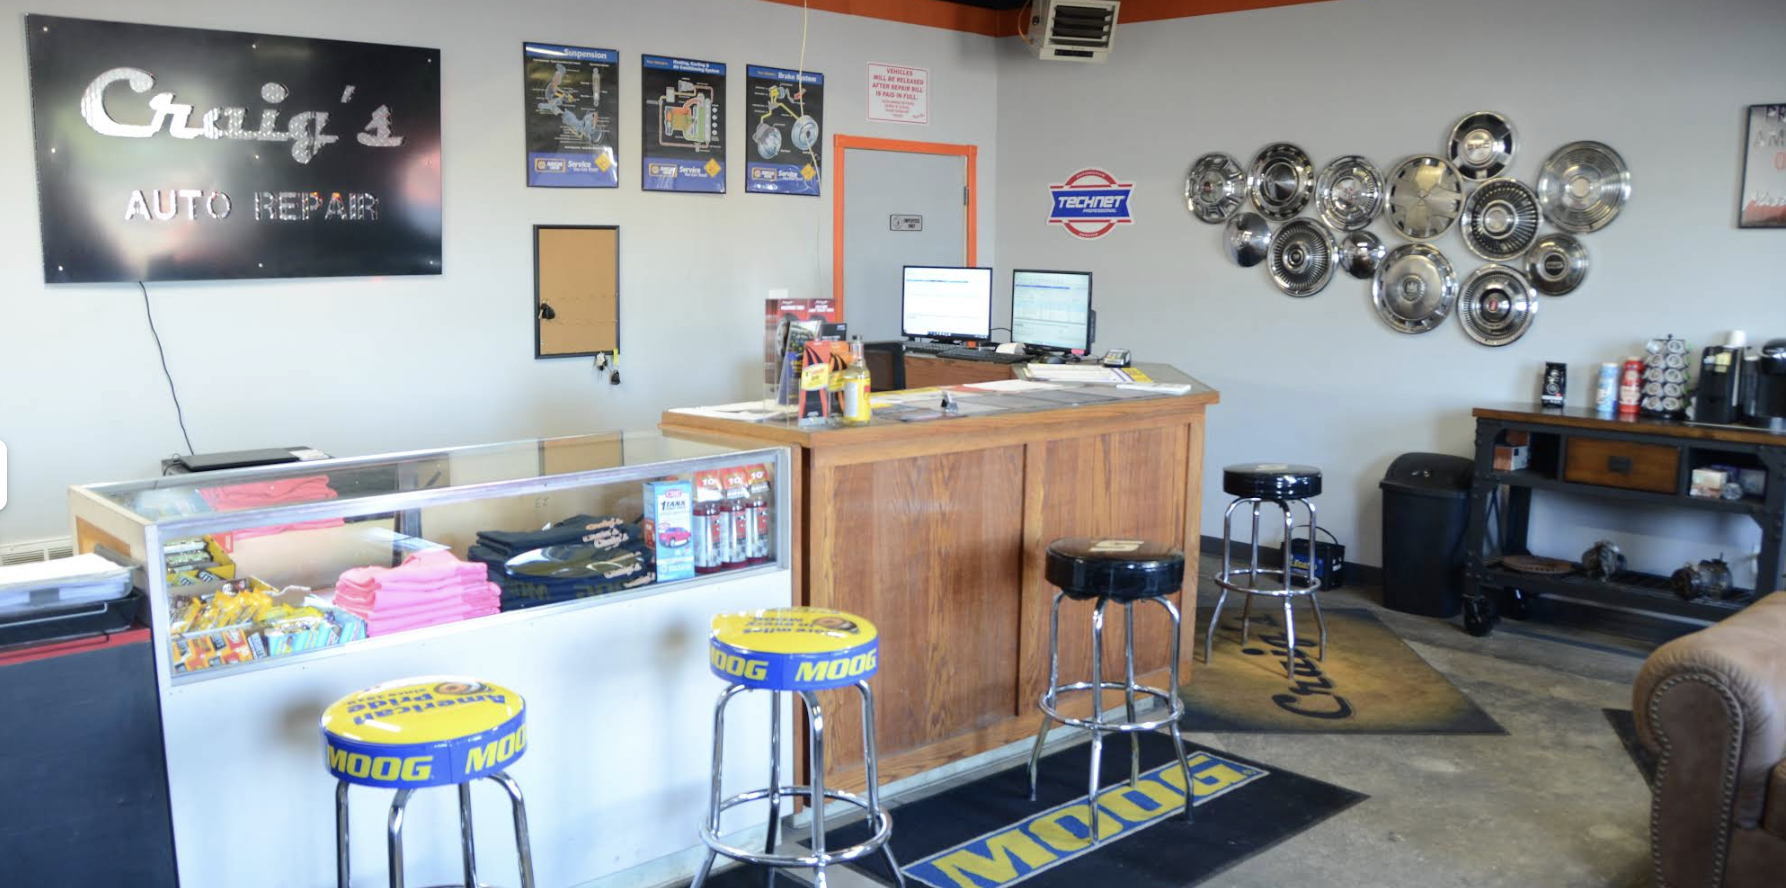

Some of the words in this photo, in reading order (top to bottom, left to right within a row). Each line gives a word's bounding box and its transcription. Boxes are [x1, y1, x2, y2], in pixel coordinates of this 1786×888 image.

[564, 48, 607, 60] Suspension
[778, 72, 795, 80] Brake
[887, 67, 913, 76] VEHICLES
[896, 77, 924, 85] RELEASED
[80, 66, 405, 165] Craig's
[568, 160, 591, 168] Service
[124, 189, 233, 222] AUTO
[254, 190, 380, 222] REPAIR
[794, 648, 877, 682] MOOG
[347, 692, 434, 714] Pride
[352, 694, 506, 726] American
[327, 745, 435, 783] MOOG
[464, 726, 526, 775] MOO
[930, 754, 1248, 888] MOOG
